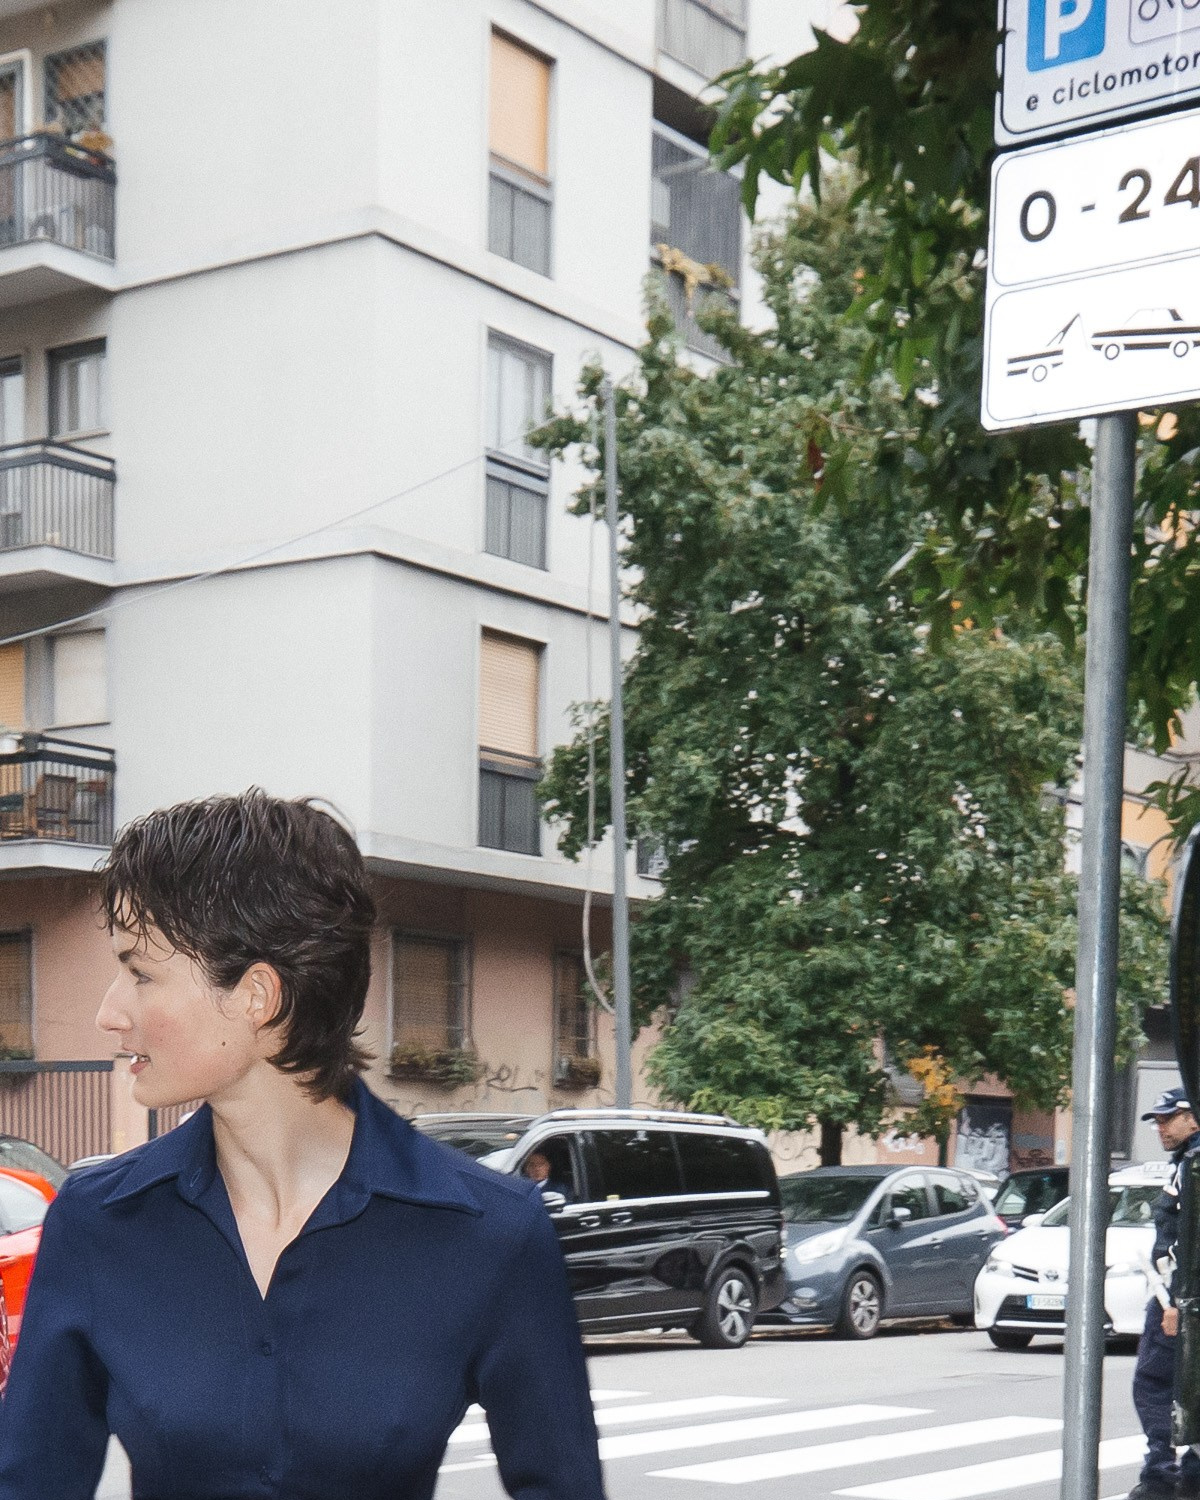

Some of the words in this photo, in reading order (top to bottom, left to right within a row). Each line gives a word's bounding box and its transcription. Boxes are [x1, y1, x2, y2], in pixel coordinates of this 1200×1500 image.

[1043, 0, 1093, 60] P
[1026, 95, 1039, 111] e
[1019, 190, 1057, 243] 0
[1117, 155, 1200, 224] 24
